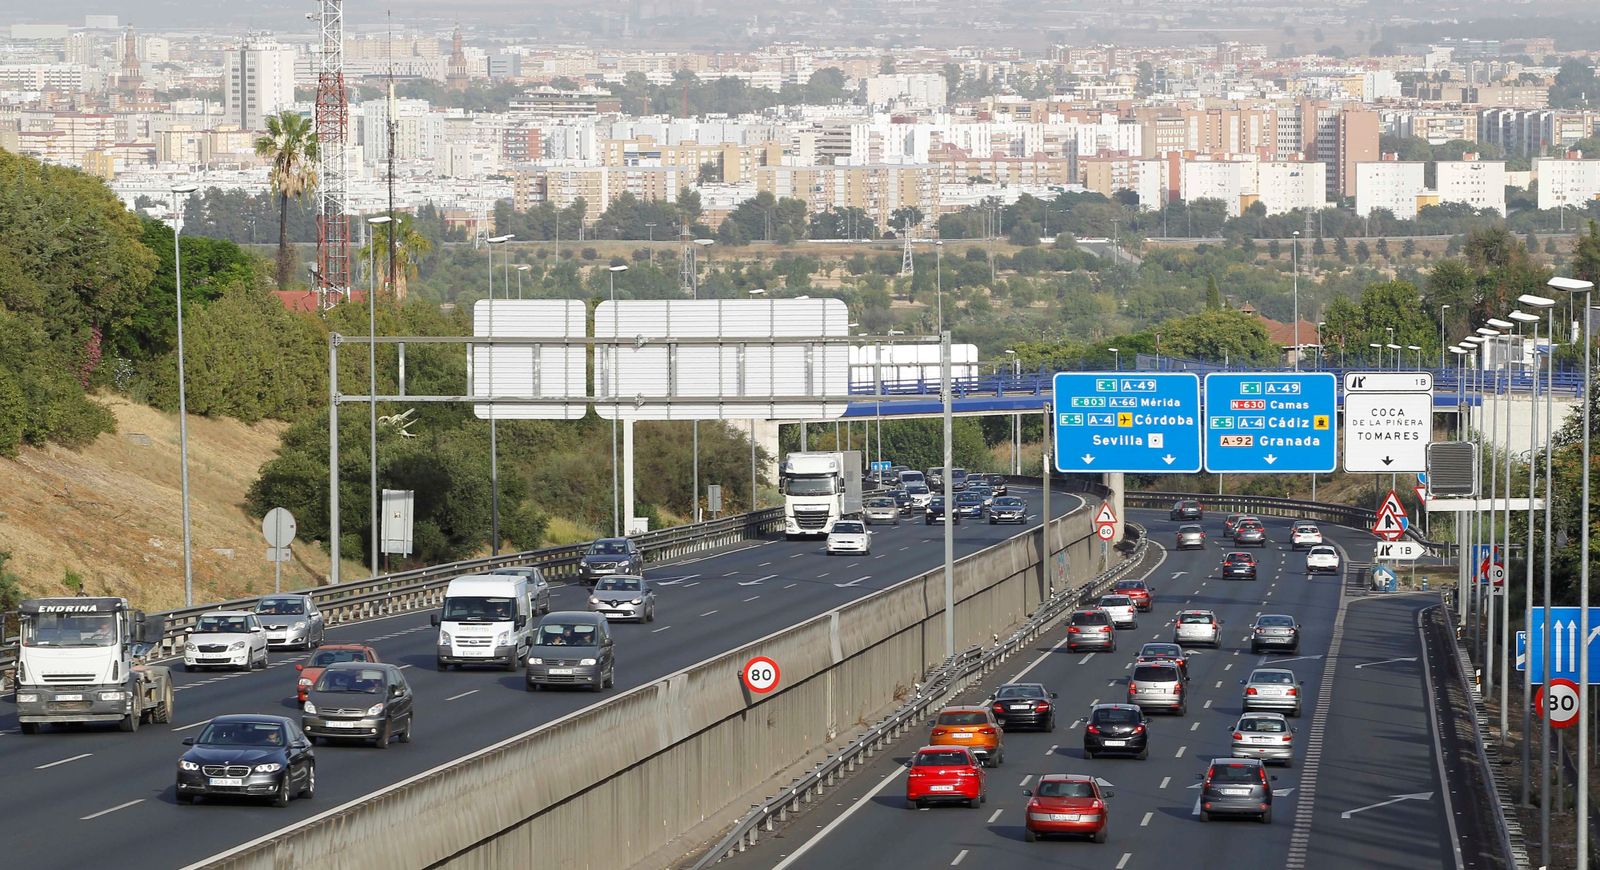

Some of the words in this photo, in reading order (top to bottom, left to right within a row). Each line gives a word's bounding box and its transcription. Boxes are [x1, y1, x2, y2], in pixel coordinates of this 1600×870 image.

[1098, 381, 1116, 390] E-1
[1123, 381, 1155, 390] A-49
[1242, 383, 1260, 393] E-1
[1267, 383, 1299, 393] A-49
[1073, 399, 1105, 407] E-803
[1110, 399, 1136, 407] A-66
[1141, 398, 1181, 407] Mérida
[1232, 401, 1264, 409] N-630
[1270, 400, 1309, 409] Camas
[1371, 408, 1405, 417] COCA
[1061, 415, 1082, 424] E-5
[1089, 415, 1113, 424] A-4
[1135, 414, 1194, 425] Córdoba
[1212, 418, 1232, 427] E-5
[1240, 418, 1263, 427] A-4
[1268, 416, 1309, 428] Cádiz
[1386, 418, 1424, 426] PIÑERA
[1093, 434, 1143, 446] Sevilla
[1221, 436, 1252, 446] A-92
[1259, 435, 1320, 446] Granada
[1358, 432, 1419, 440] TOMARES
[1400, 546, 1412, 555] 1B
[38, 604, 97, 613] ENDRINA
[751, 669, 772, 681] 80
